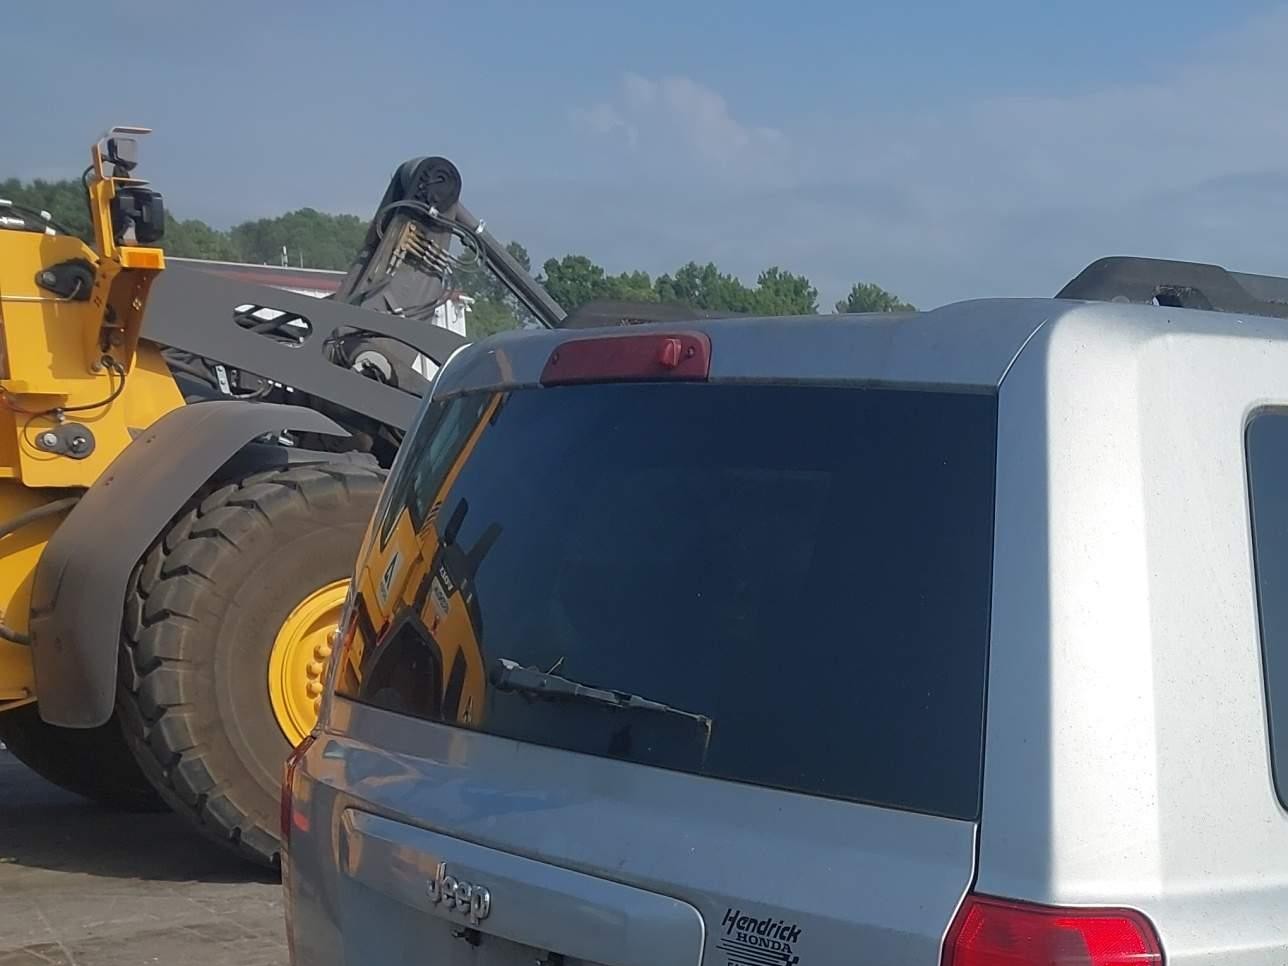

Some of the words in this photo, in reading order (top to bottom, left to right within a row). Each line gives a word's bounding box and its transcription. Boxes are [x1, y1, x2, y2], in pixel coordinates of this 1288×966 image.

[425, 861, 492, 927] Jeep
[721, 908, 802, 943] Hendrick
[736, 931, 793, 954] HONDA
